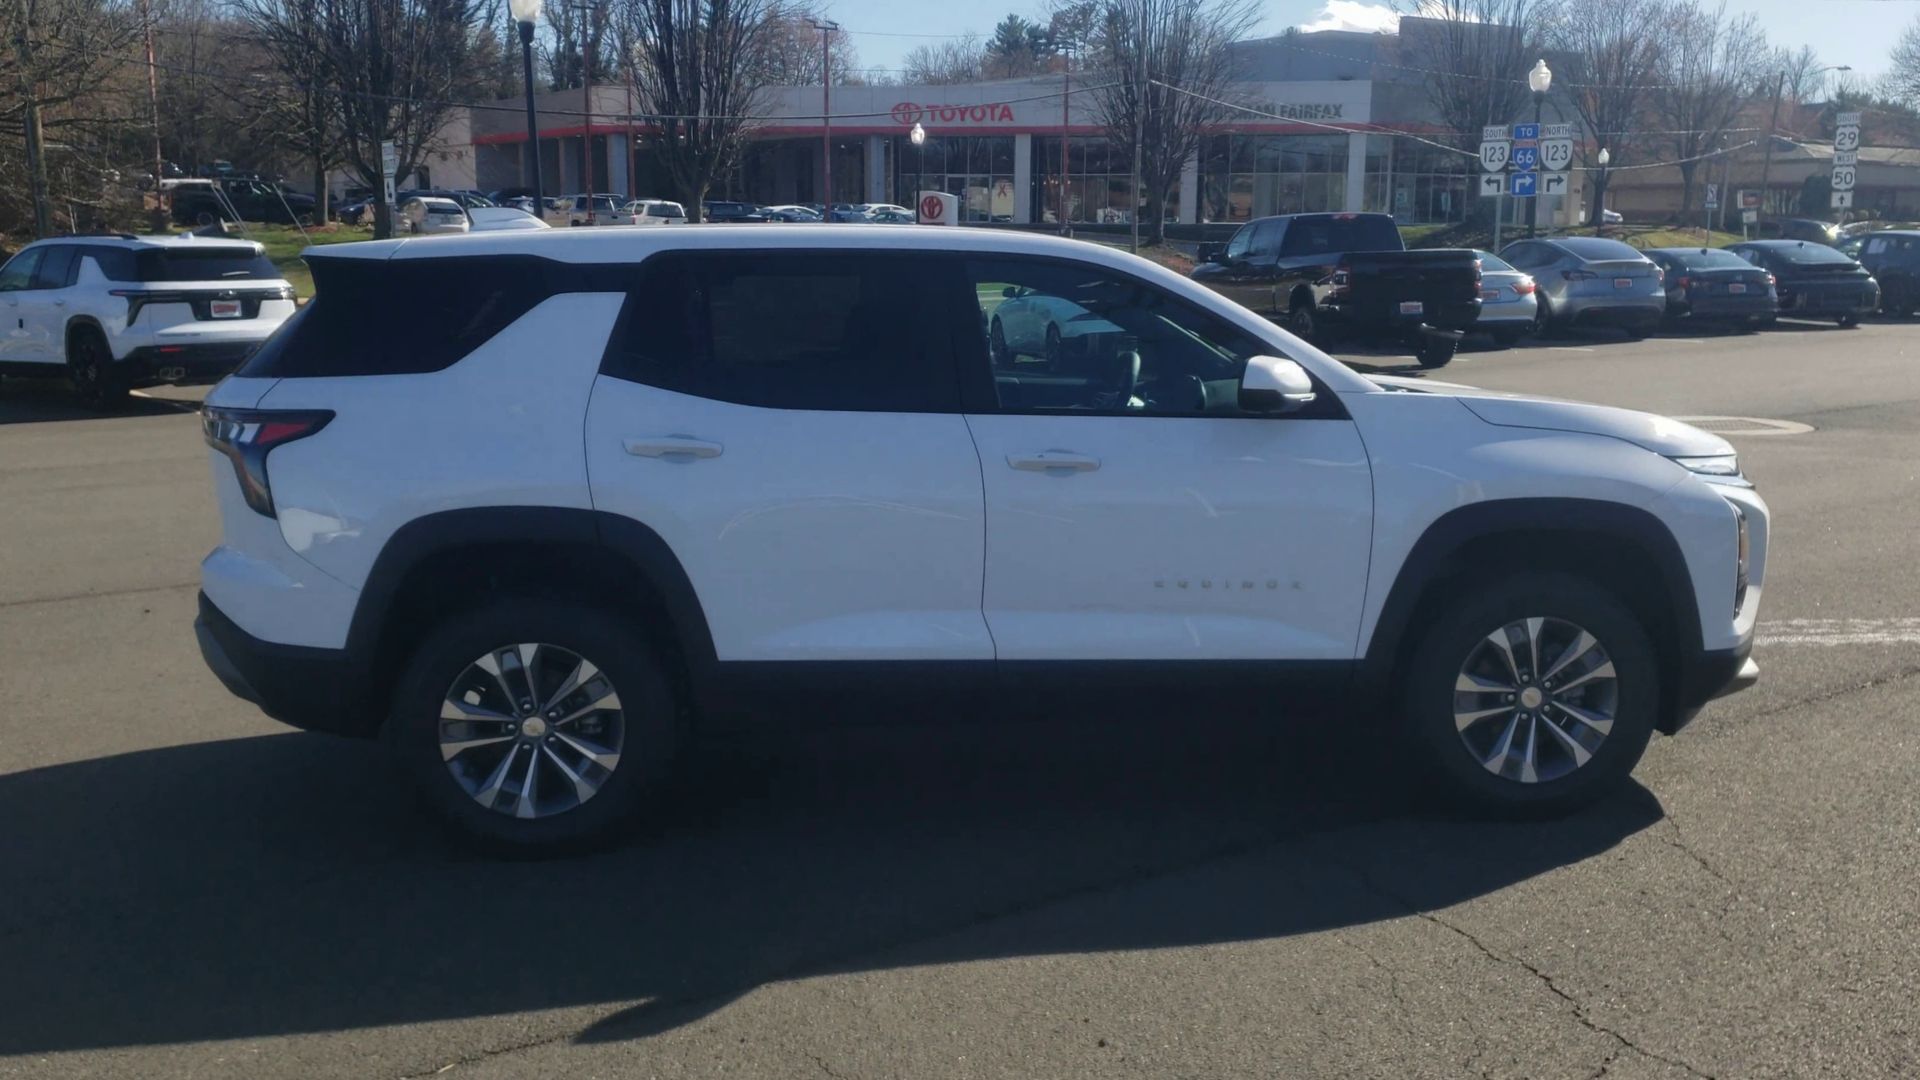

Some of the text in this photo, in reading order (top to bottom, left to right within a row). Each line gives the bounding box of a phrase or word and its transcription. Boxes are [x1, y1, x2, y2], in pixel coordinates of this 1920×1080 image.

[926, 104, 1014, 122] TOYOTA
[1520, 127, 1533, 137] TO
[1546, 125, 1569, 136] NORTH
[1837, 131, 1857, 146] 29
[1484, 146, 1505, 163] 123
[1516, 150, 1534, 164] 66
[1546, 144, 1568, 161] 123
[1834, 171, 1853, 185] 50
